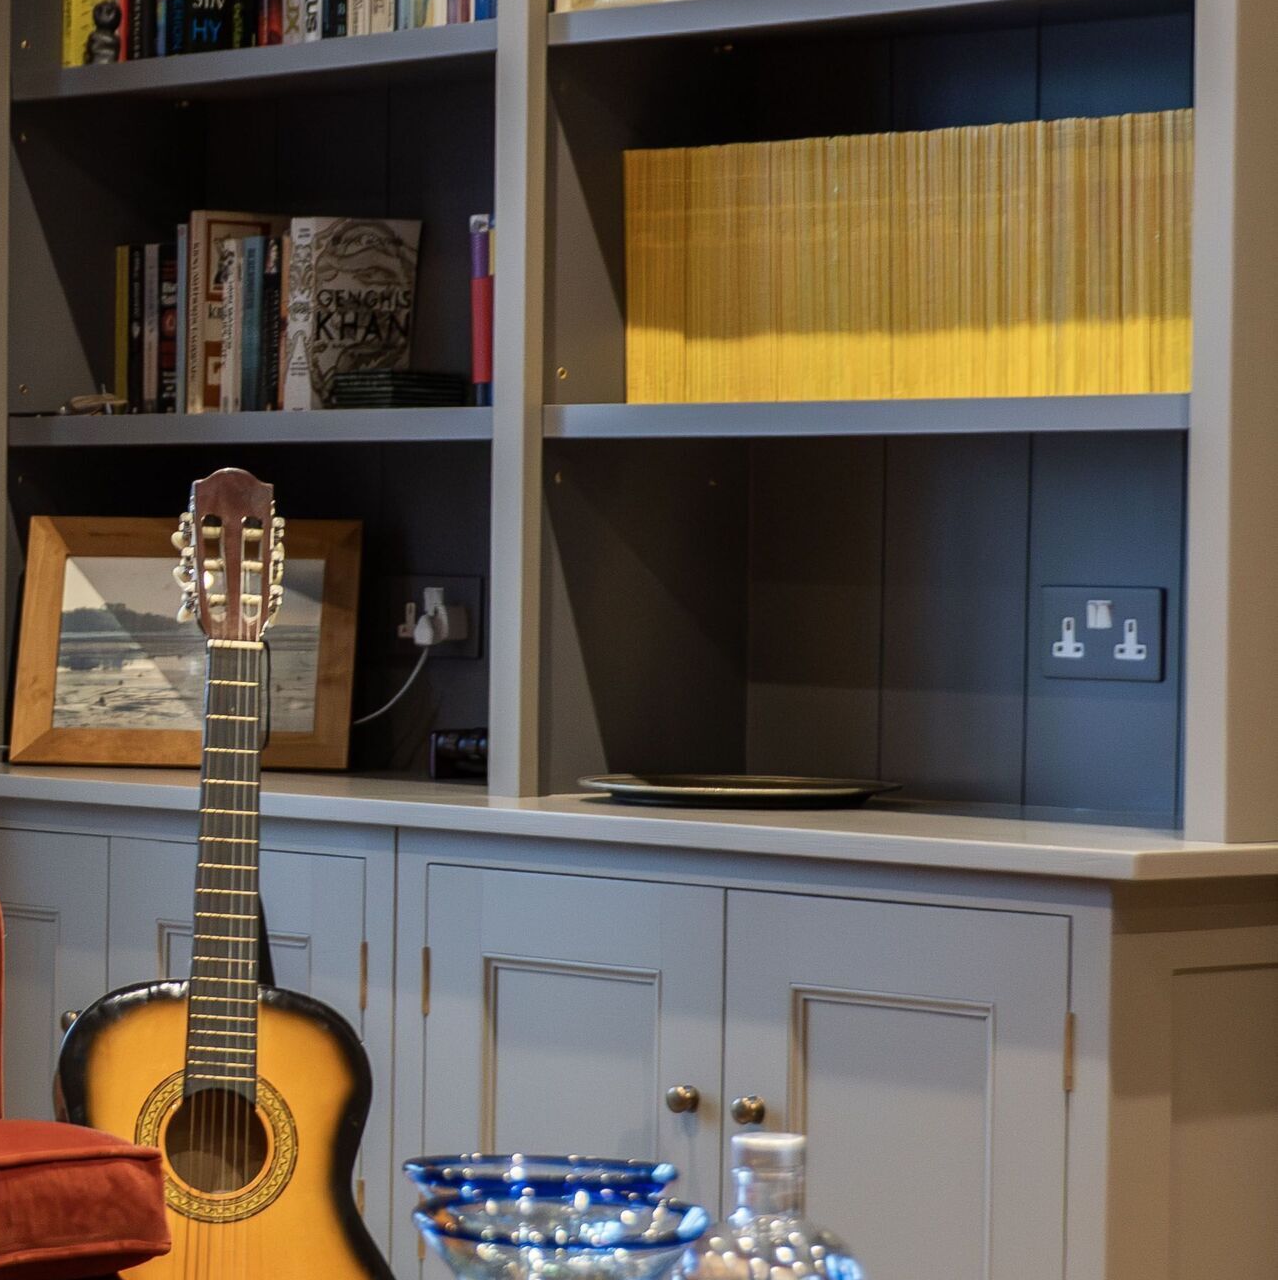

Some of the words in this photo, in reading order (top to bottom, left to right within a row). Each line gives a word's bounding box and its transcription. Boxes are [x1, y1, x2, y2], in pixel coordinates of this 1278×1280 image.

[191, 16, 222, 43] HY
[316, 288, 412, 310] GENGHIS
[316, 311, 412, 341] KHAN
